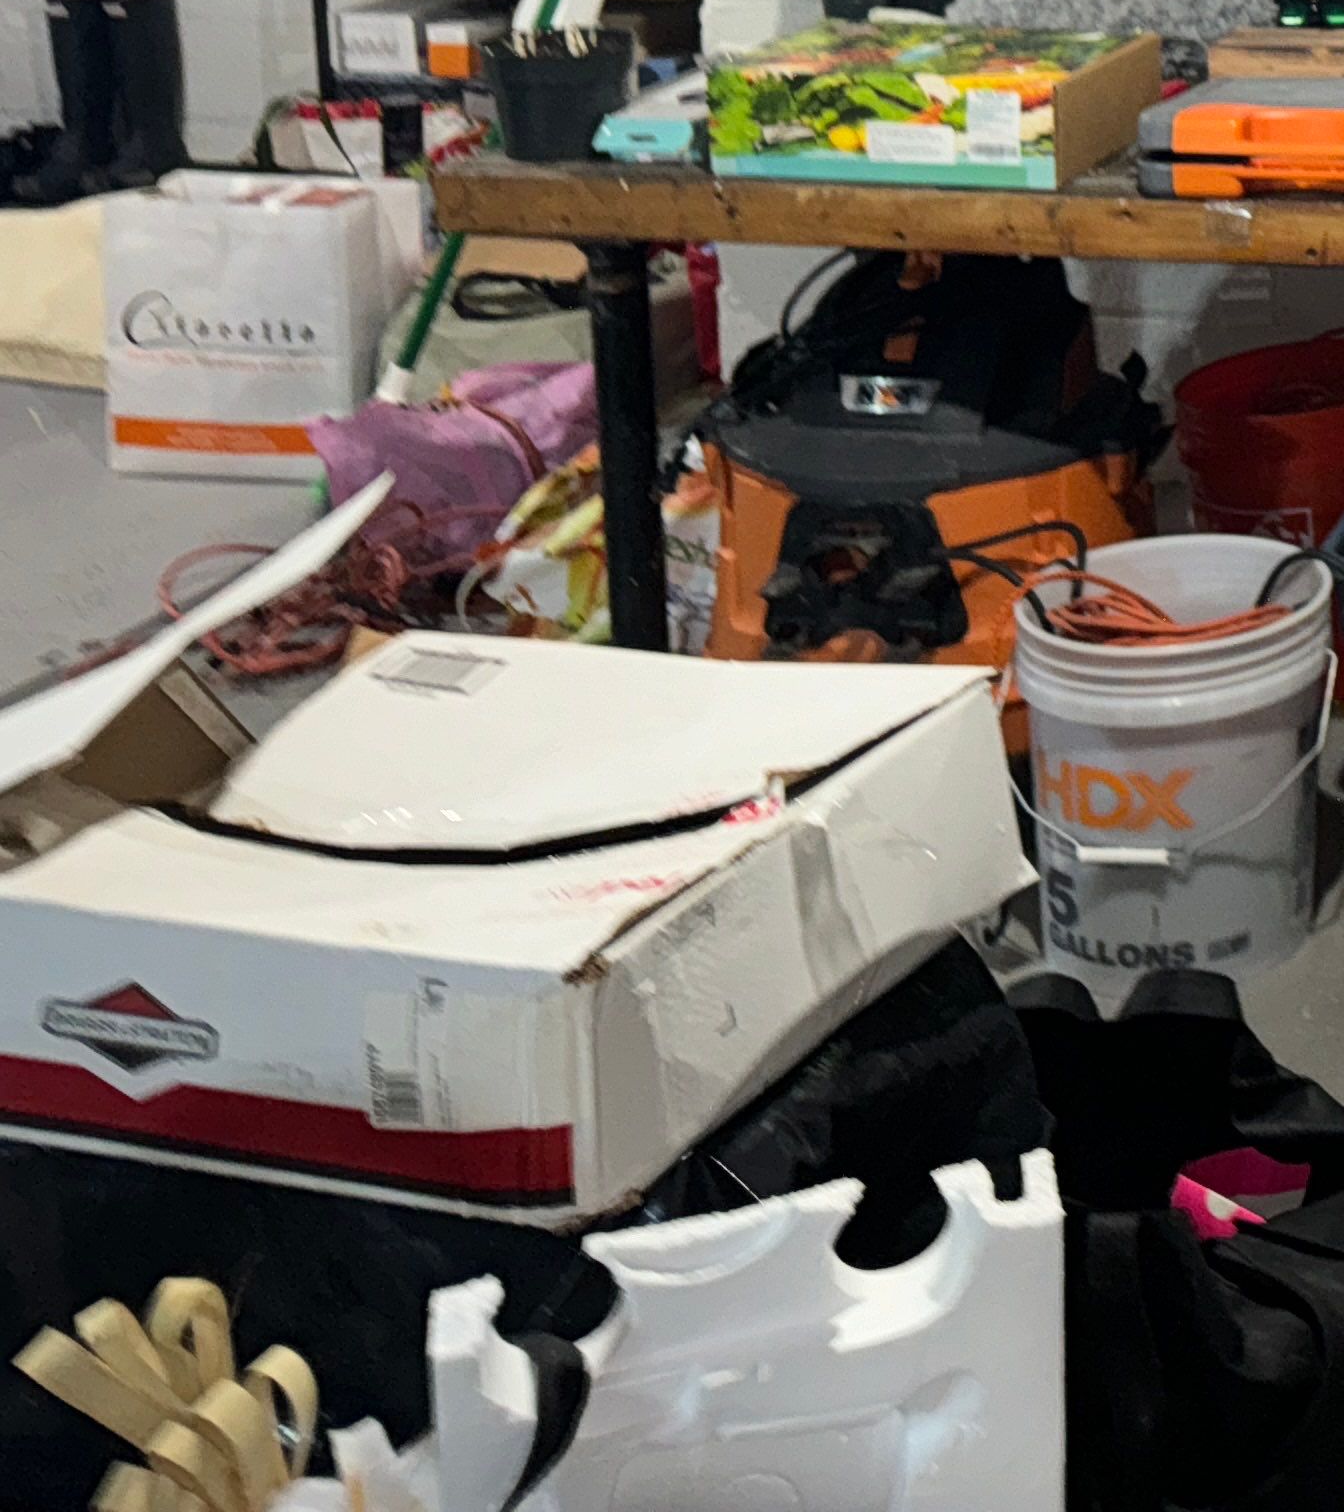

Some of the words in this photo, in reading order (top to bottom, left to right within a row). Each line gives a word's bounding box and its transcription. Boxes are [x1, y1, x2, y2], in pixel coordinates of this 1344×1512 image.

[1037, 745, 1196, 831] HDX
[1047, 866, 1079, 928] 5
[1049, 922, 1197, 970] GALLONS
